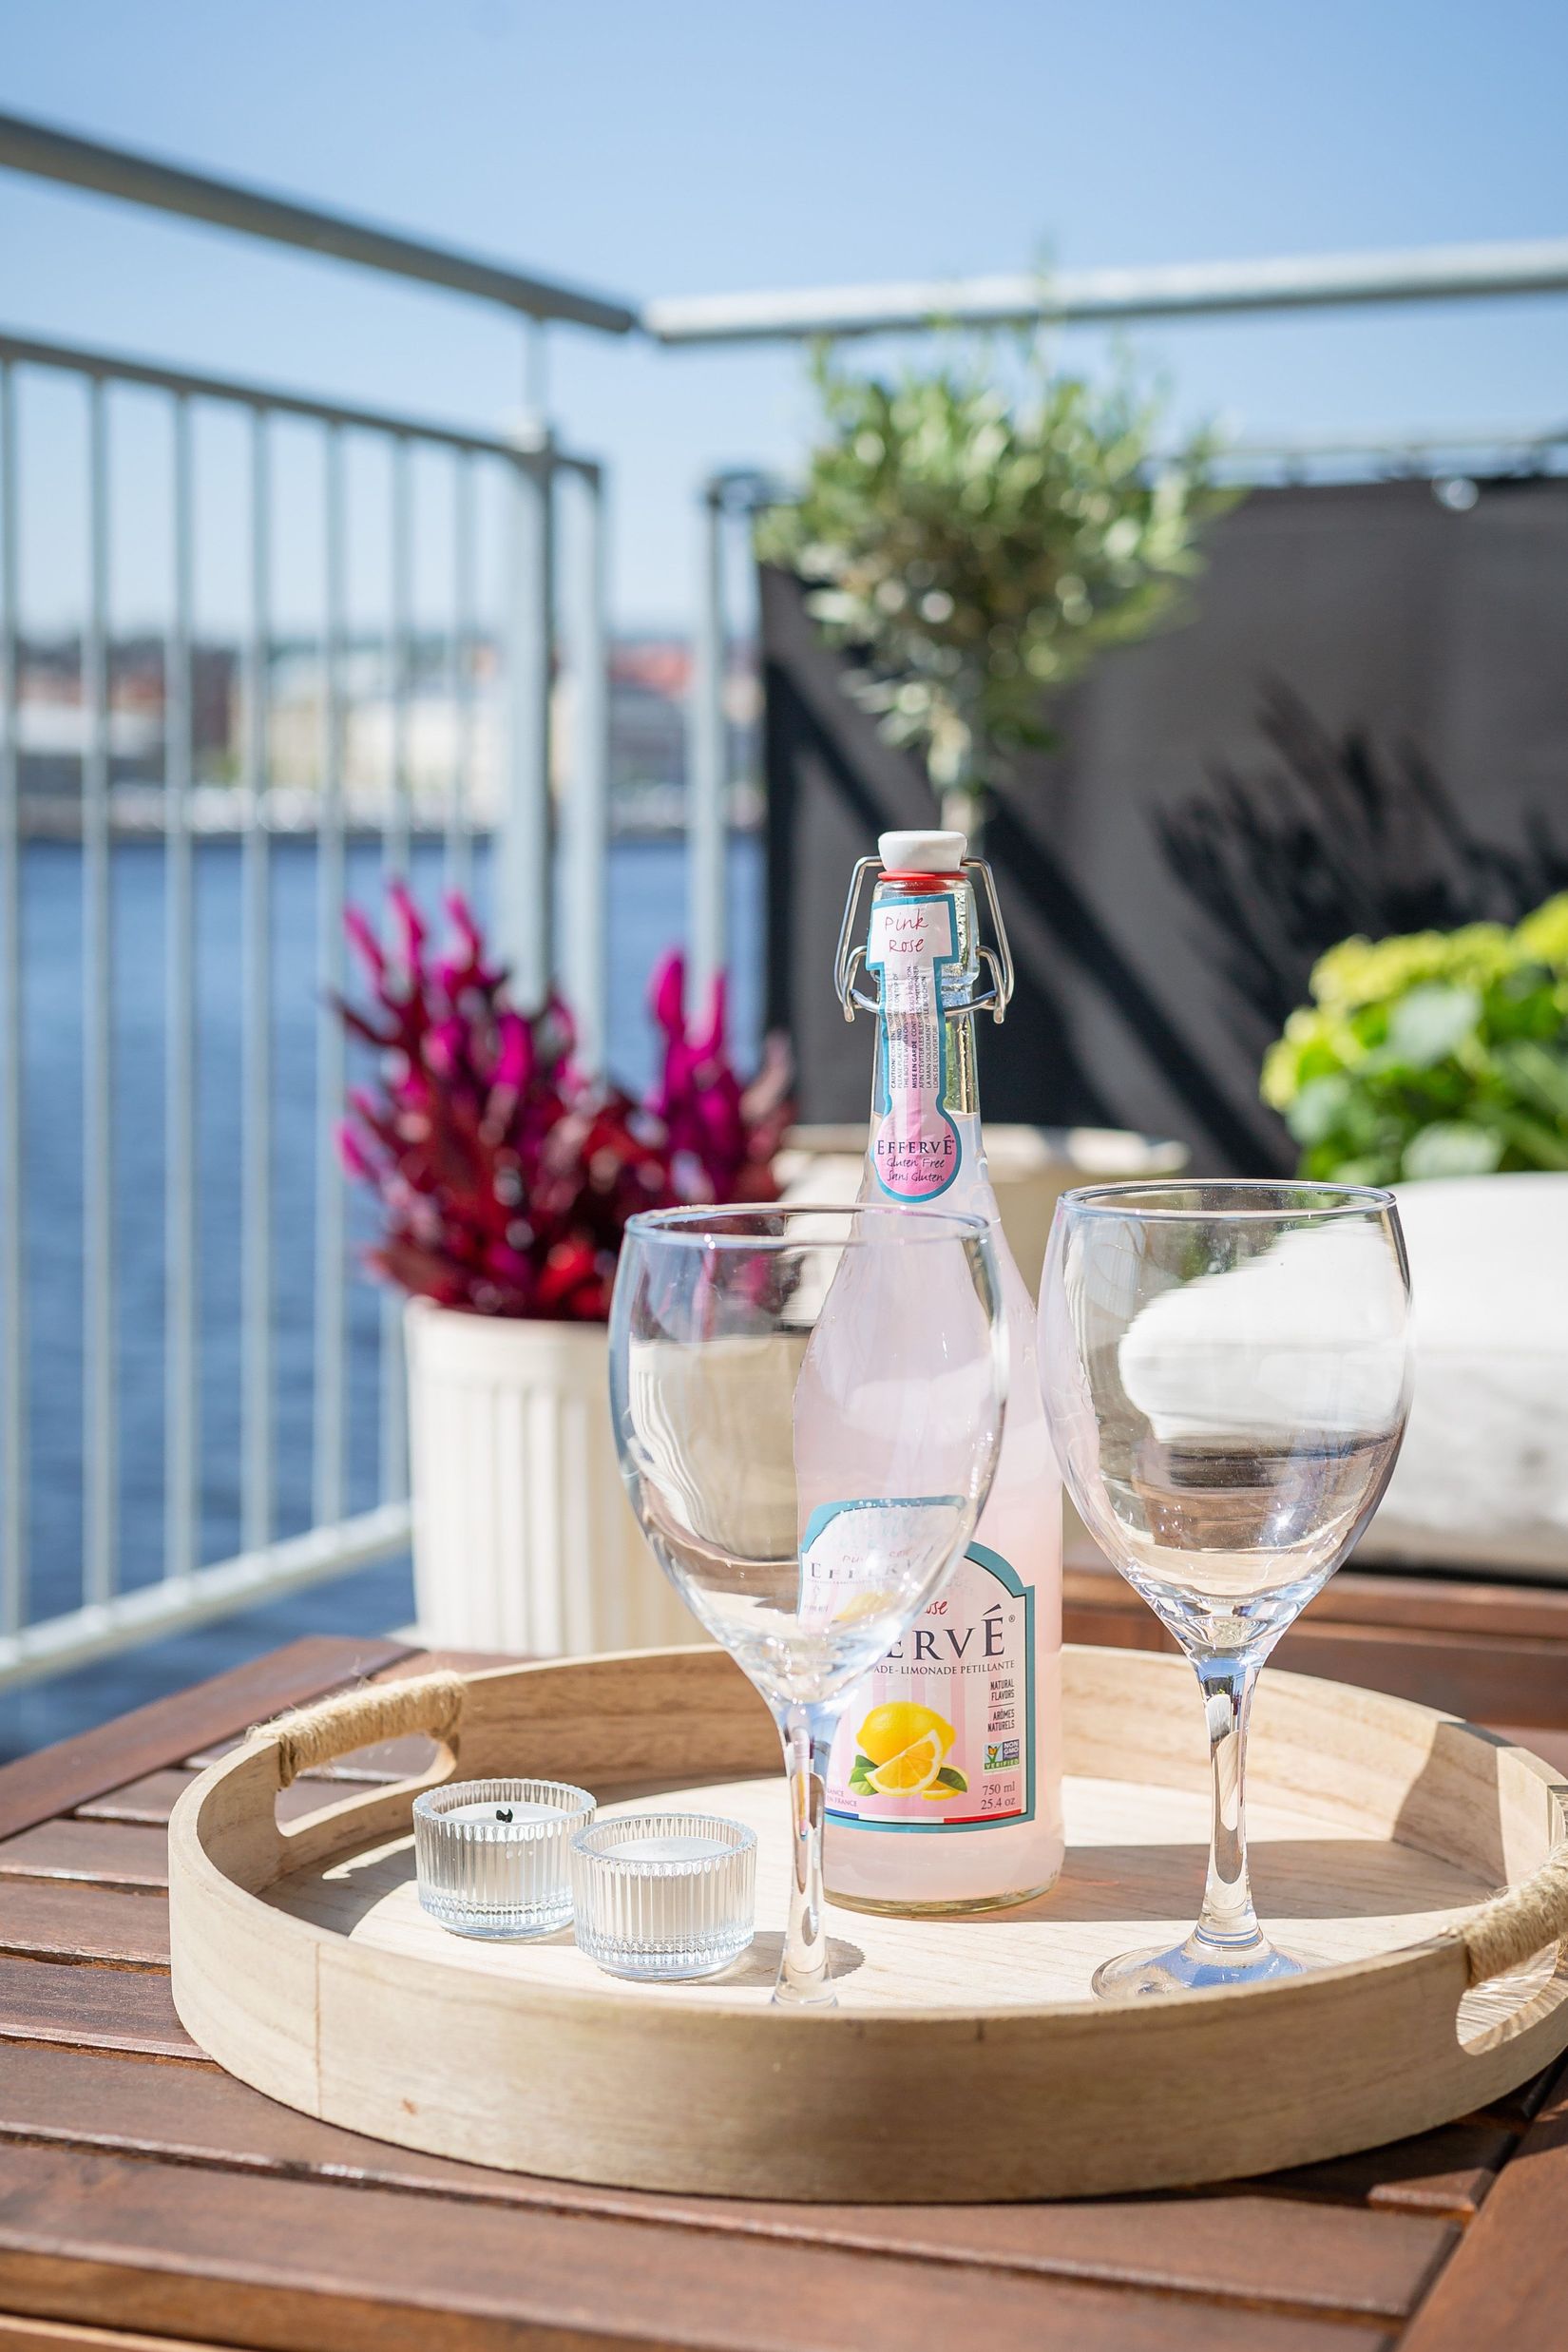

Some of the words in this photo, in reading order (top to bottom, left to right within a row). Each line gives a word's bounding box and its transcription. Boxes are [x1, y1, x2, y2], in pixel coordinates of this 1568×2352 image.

[885, 908, 929, 931] Pink
[912, 1063, 917, 1072] EN
[933, 1063, 939, 1072] DE
[877, 1135, 954, 1156] EFFERVÉ
[887, 1156, 919, 1168] Gluten
[922, 1157, 945, 1168] Free
[888, 1170, 908, 1181] Sans
[910, 1170, 945, 1182] Gluten
[901, 1666, 957, 1675] LIMONADE
[960, 1660, 1016, 1674] PETILLANTE
[990, 1678, 1014, 1691] NATURAL
[991, 1689, 1014, 1702] FLAVORS
[987, 1719, 1015, 1732] NATURELS
[985, 1759, 1019, 1769] VERIFIED
[983, 1785, 1001, 1796] 750
[1004, 1781, 1015, 1793] ml
[981, 1798, 1002, 1809] 25.4
[1004, 1797, 1016, 1806] oz
